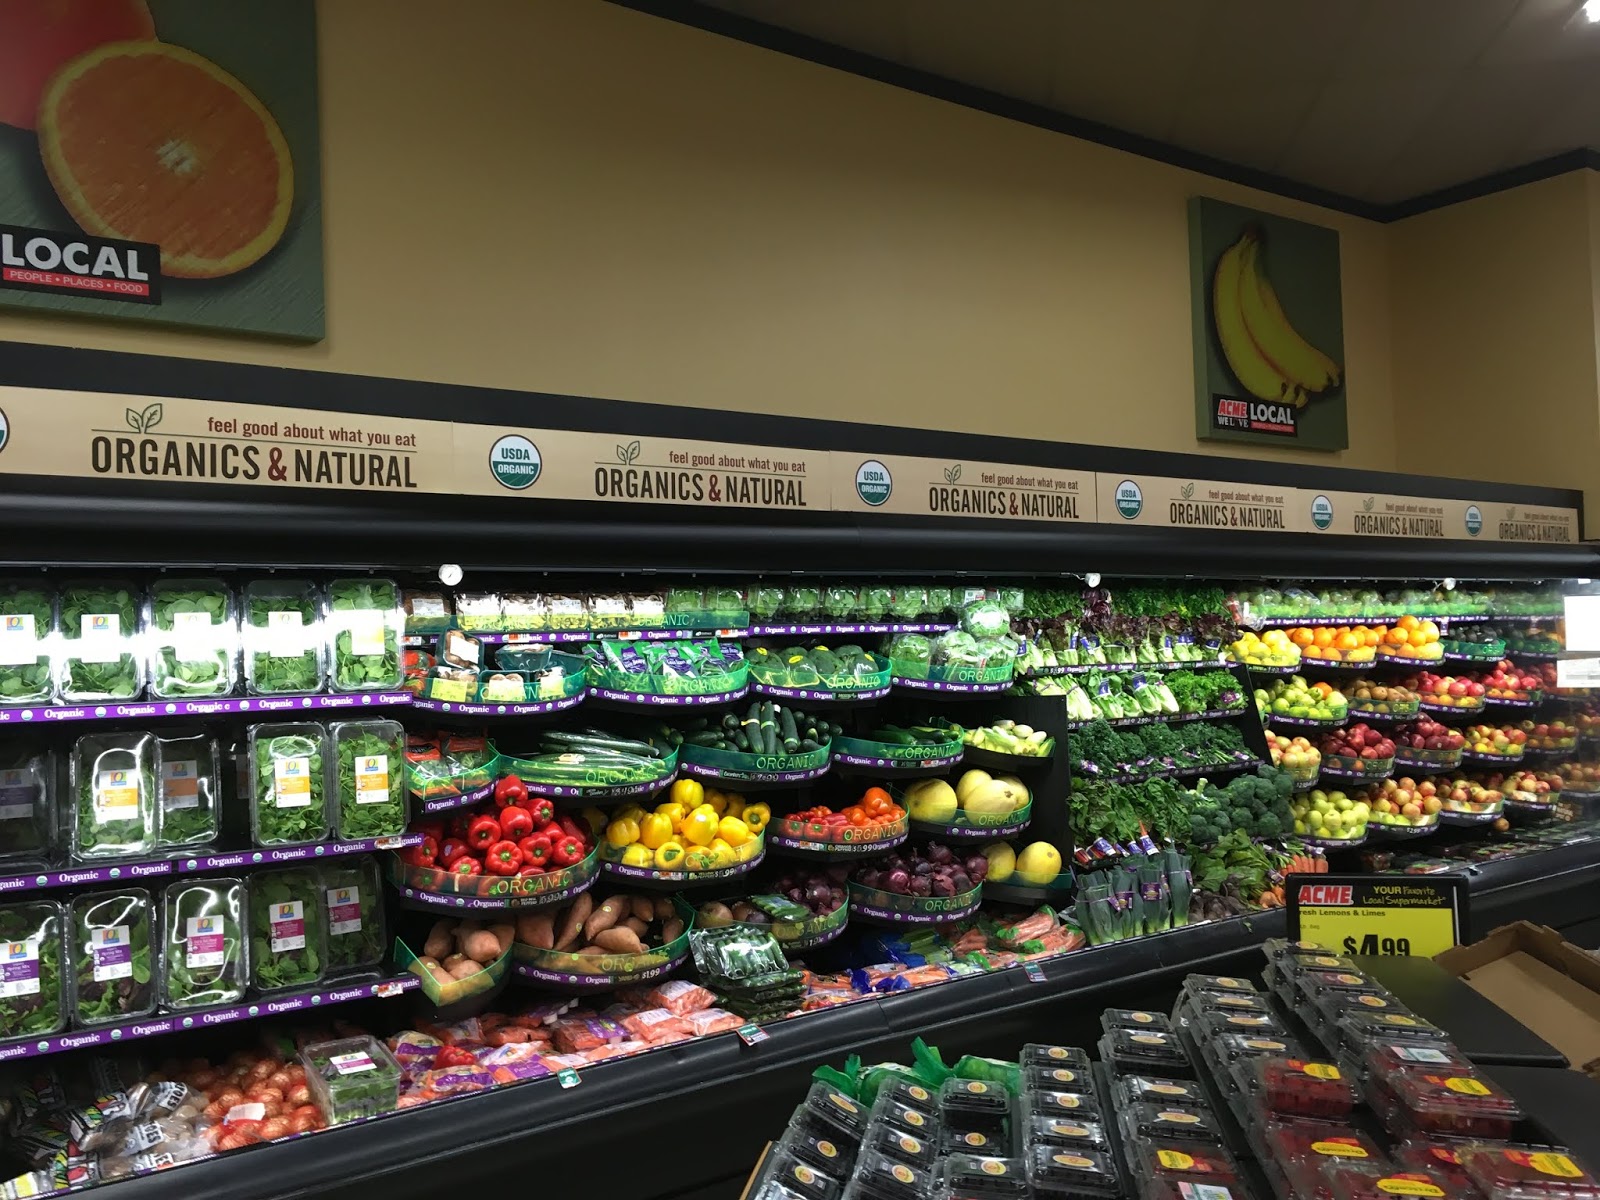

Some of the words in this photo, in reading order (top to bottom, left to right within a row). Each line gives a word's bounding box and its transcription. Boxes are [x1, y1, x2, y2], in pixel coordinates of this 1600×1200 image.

[2, 234, 148, 281] LOCAL
[11, 271, 52, 282] PEOPLE
[64, 277, 103, 289] PLACES
[114, 283, 143, 293] FOOD
[1218, 399, 1247, 418] ACME
[1250, 403, 1294, 424] LOCAL
[1218, 416, 1228, 425] WE
[1229, 418, 1248, 427] LVE
[207, 416, 237, 434] feel
[243, 420, 278, 438] good
[283, 424, 324, 440] about
[329, 428, 362, 443] what
[367, 432, 391, 447] you
[395, 433, 417, 447] eat
[501, 448, 530, 461] USDA
[91, 436, 260, 480] ORGANICS
[267, 447, 287, 482] &
[295, 449, 417, 488] NATURAL
[669, 451, 688, 464] feel
[692, 453, 715, 467] good
[718, 455, 745, 469] about
[748, 458, 770, 471] what
[773, 461, 789, 474] you
[791, 462, 806, 473] eat
[497, 464, 535, 475] ORGANIC
[864, 471, 884, 481] USDA
[595, 467, 703, 500] ORGANICS
[708, 475, 722, 502] &
[726, 476, 806, 506] NATURAL
[981, 473, 996, 484] feel
[997, 475, 1014, 486] good
[1016, 477, 1035, 487] about
[1037, 478, 1053, 488] what
[1054, 480, 1067, 490] you
[1068, 481, 1078, 490] eat
[861, 484, 887, 494] ORGANIC
[1121, 489, 1136, 498] USDA
[929, 488, 1005, 515] ORGANICS
[1009, 493, 1018, 515] &
[1022, 494, 1079, 519] NATURAL
[1209, 490, 1219, 499] feel
[1221, 491, 1233, 501] good
[1235, 493, 1250, 501] about
[1251, 494, 1263, 502] what
[1265, 496, 1274, 504] you
[1170, 503, 1228, 526] ORGANICS
[1231, 506, 1237, 526] &
[1240, 507, 1285, 528] NATURAL
[1354, 515, 1400, 534] ORGANICS
[1402, 518, 1407, 535] &
[1409, 518, 1444, 536] NATURAL
[1499, 523, 1535, 540] ORGANICS
[1543, 526, 1570, 542] NATURAL
[801, 625, 821, 633] Organic
[836, 625, 855, 633] Organic
[902, 624, 920, 632] Organic
[562, 633, 587, 641] Organic
[1307, 658, 1326, 666] Organic
[959, 671, 1006, 682] ORGANIC
[905, 679, 927, 688] Organic
[947, 684, 968, 692] Organic
[604, 691, 630, 700] Organic
[652, 696, 678, 704] Organic
[699, 695, 720, 703] Organic
[769, 687, 793, 696] Organic
[814, 692, 832, 700] Organ
[44, 709, 84, 720] Organic
[117, 705, 155, 716] Organic
[259, 699, 293, 709] Organic
[321, 697, 353, 706] Organic
[379, 694, 410, 703] Organic
[413, 701, 435, 709] rganic
[459, 704, 489, 713] Organic
[514, 705, 540, 713] Organic
[905, 745, 954, 759] ORGANIC
[756, 755, 815, 770] ORGANIC
[847, 756, 871, 766] Organic
[694, 766, 719, 777] Organic
[785, 772, 805, 780] Organic
[526, 785, 547, 794] rganic
[428, 799, 455, 810] Organic
[472, 787, 489, 800] Organic
[979, 811, 1024, 826] ORGANIC
[844, 823, 899, 841] ORGANIC
[965, 828, 986, 836] Organic
[1002, 827, 1018, 835] Organic
[0, 878, 25, 891] ganic
[59, 872, 98, 884] Organic
[131, 865, 169, 877] Organic
[207, 855, 243, 867] Organic
[272, 849, 306, 860] Organic
[333, 842, 365, 853] Organic
[401, 836, 422, 846] ganic
[619, 866, 645, 877] Organic
[497, 871, 571, 894] ORGANIC
[1298, 885, 1354, 905] ACME
[1373, 886, 1401, 894] YOUR
[1403, 886, 1435, 895] Favorite
[420, 892, 448, 904] Organic
[473, 899, 504, 908] Organic
[924, 893, 975, 912] ORGANIC
[1362, 896, 1384, 905] Local
[1386, 896, 1443, 907] Supermarket
[864, 907, 888, 918] Organic
[948, 911, 966, 921] Organic
[533, 969, 561, 982] Organic
[585, 976, 610, 984] Organi
[642, 968, 661, 980] $1.99
[0, 1046, 26, 1059] ganic
[60, 1033, 100, 1048] Organic
[133, 1022, 171, 1035] Organic
[203, 1010, 239, 1024] Organic
[268, 999, 302, 1012] Organic
[330, 988, 362, 1000] Organic
[401, 979, 419, 988] anic
